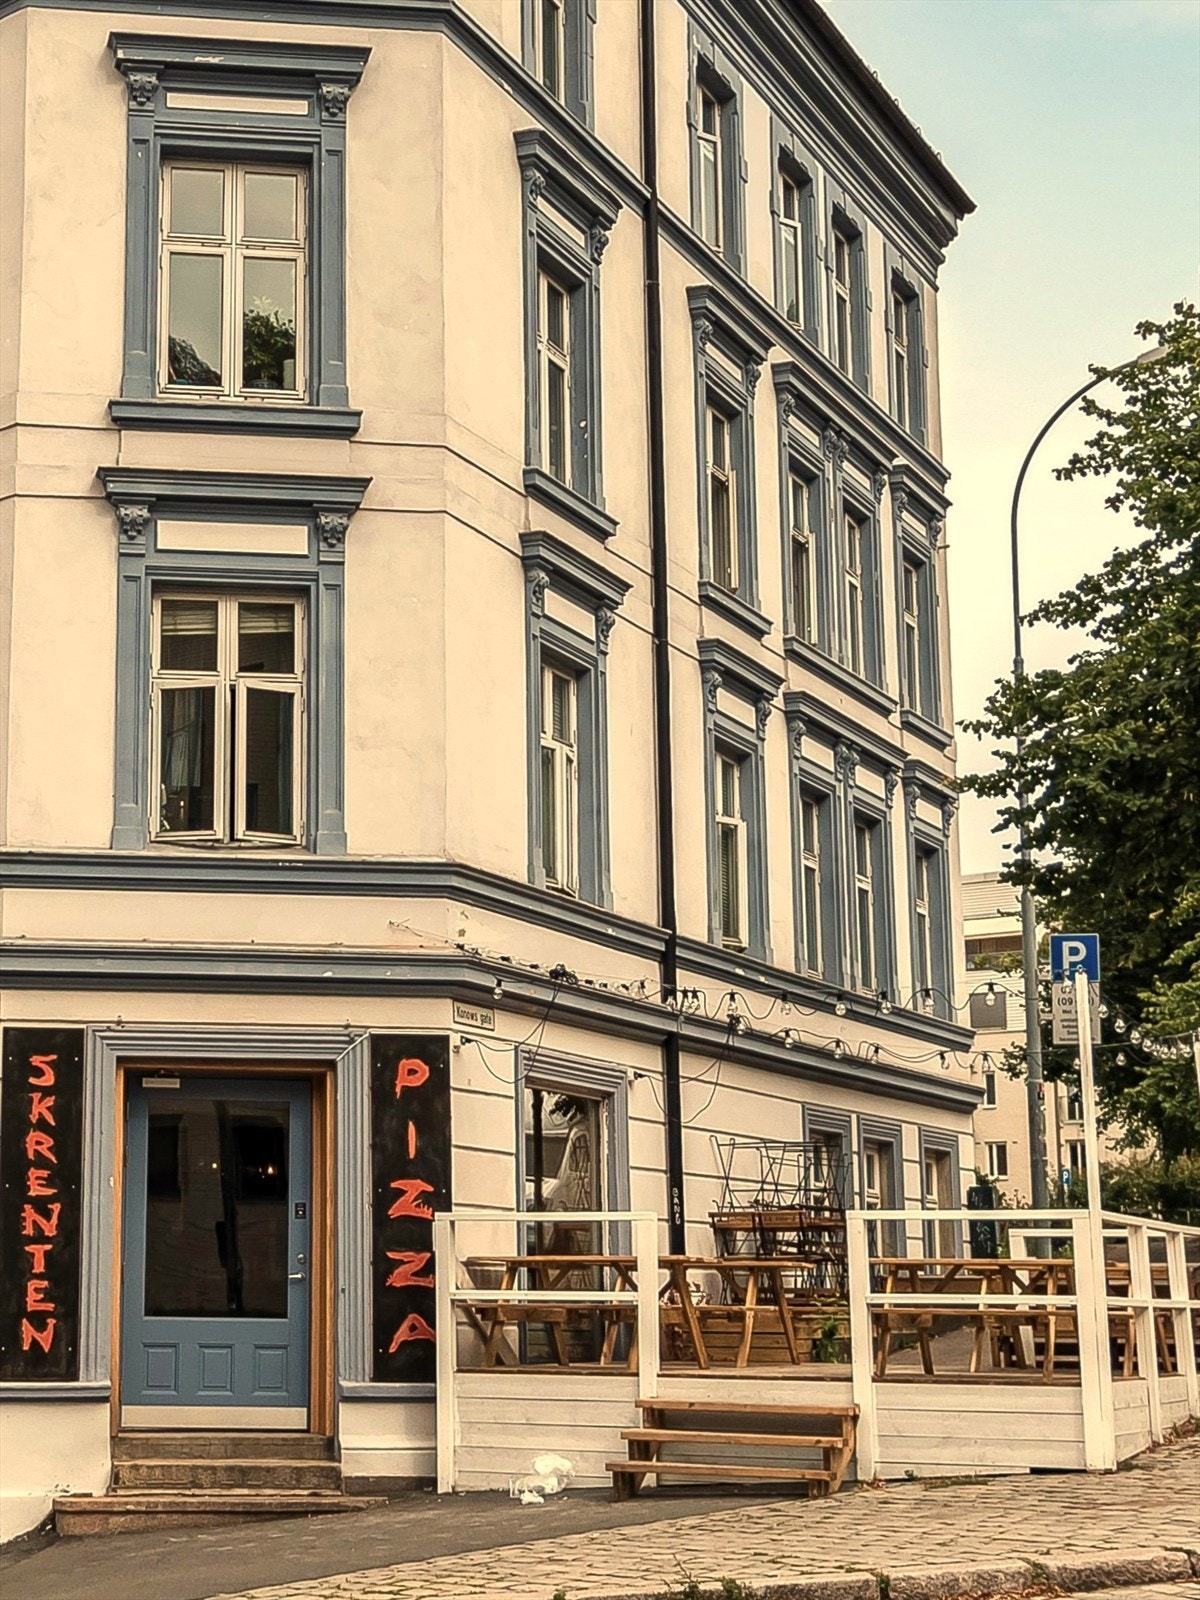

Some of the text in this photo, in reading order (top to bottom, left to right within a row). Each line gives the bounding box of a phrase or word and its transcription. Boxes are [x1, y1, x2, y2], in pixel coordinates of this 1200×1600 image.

[1062, 941, 1087, 976] P
[21, 1054, 61, 1353] SKRENTEN
[386, 1057, 435, 1353] PIZZA
[1063, 1171, 1069, 1182] P
